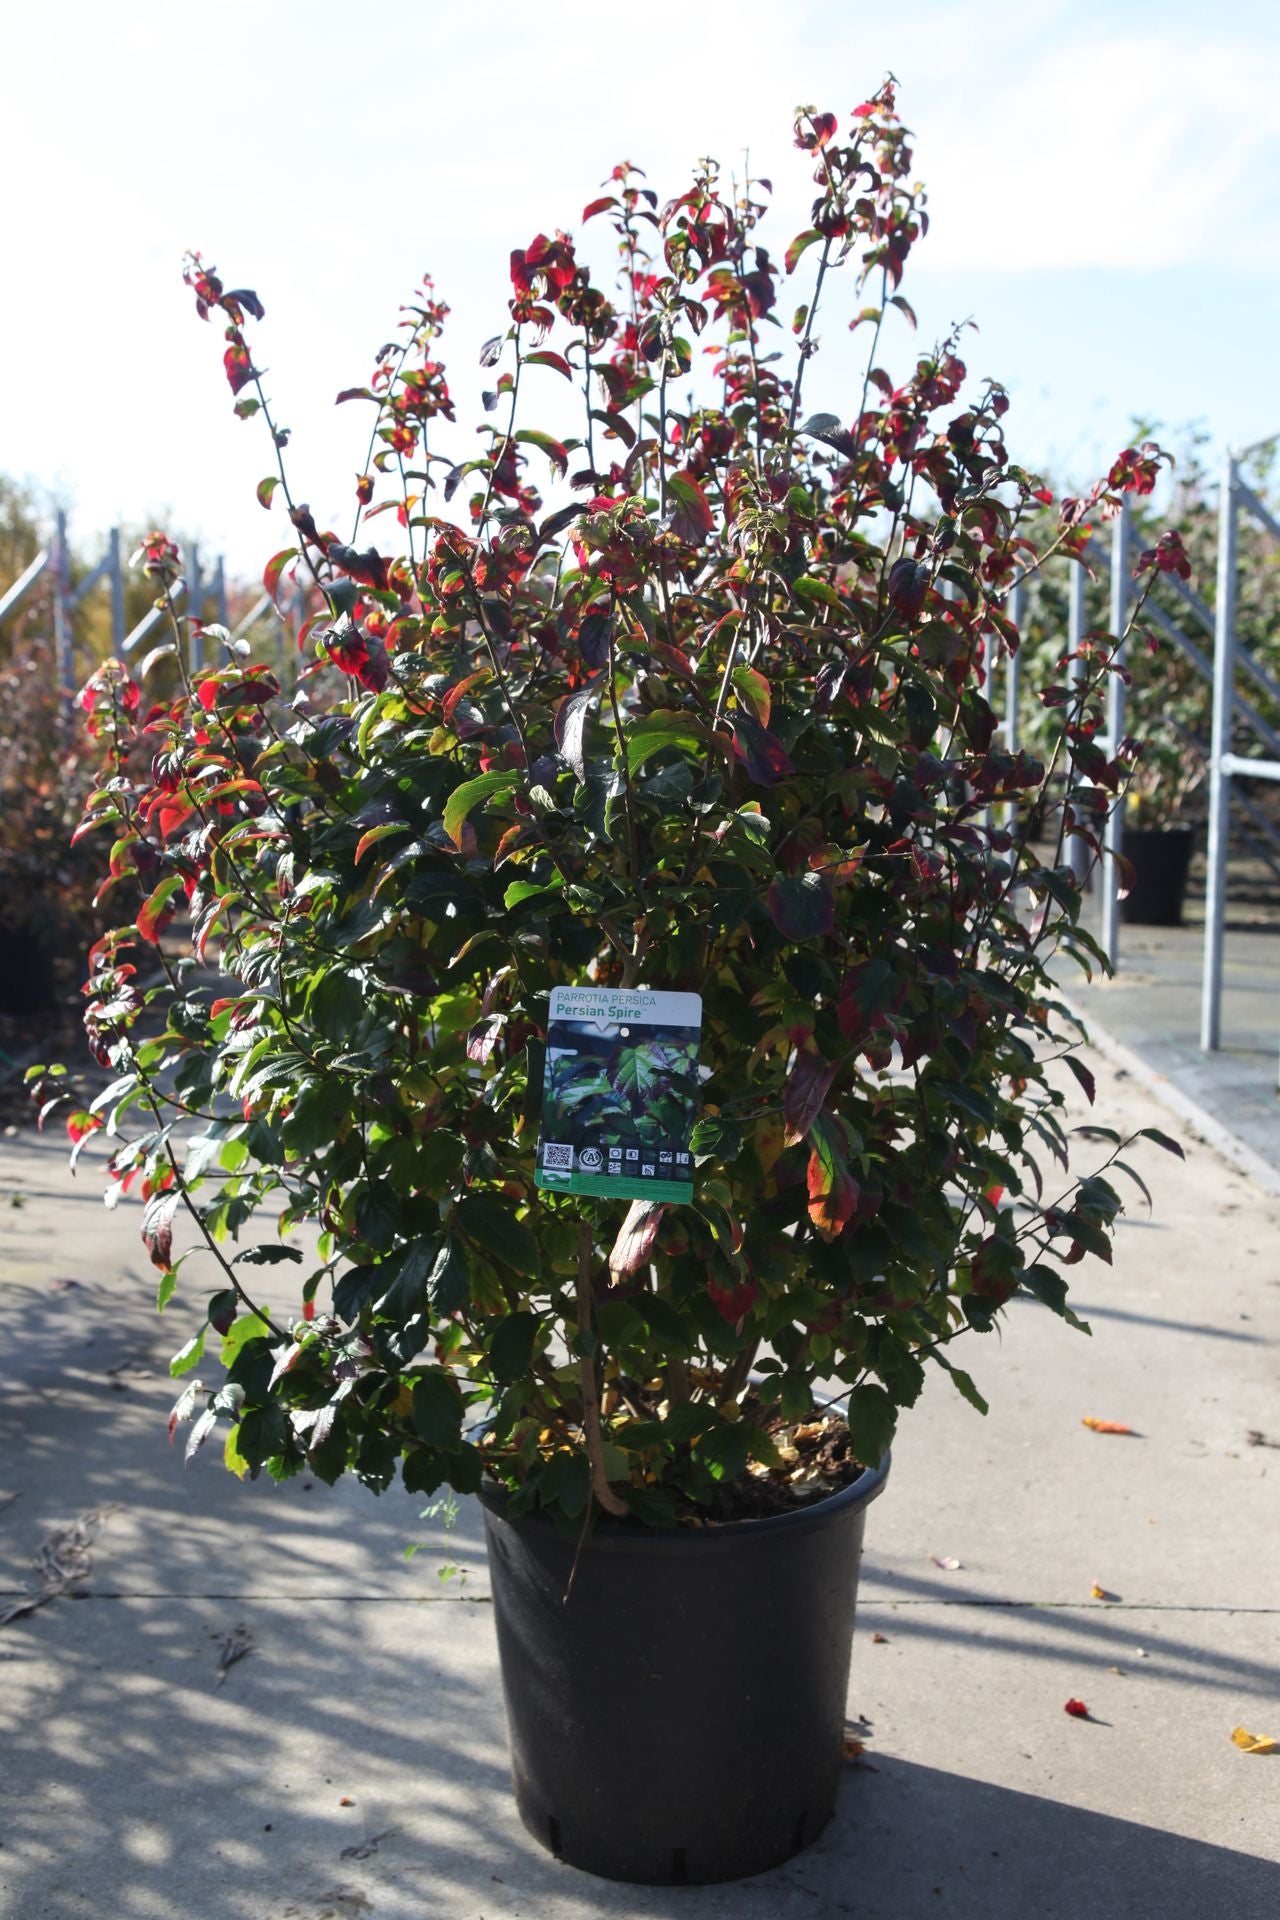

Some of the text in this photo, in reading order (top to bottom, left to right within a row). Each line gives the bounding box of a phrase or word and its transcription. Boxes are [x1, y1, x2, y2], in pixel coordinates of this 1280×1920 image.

[557, 992, 657, 1006] PARROTIA PERSICA
[556, 1003, 642, 1020] Persian Spire
